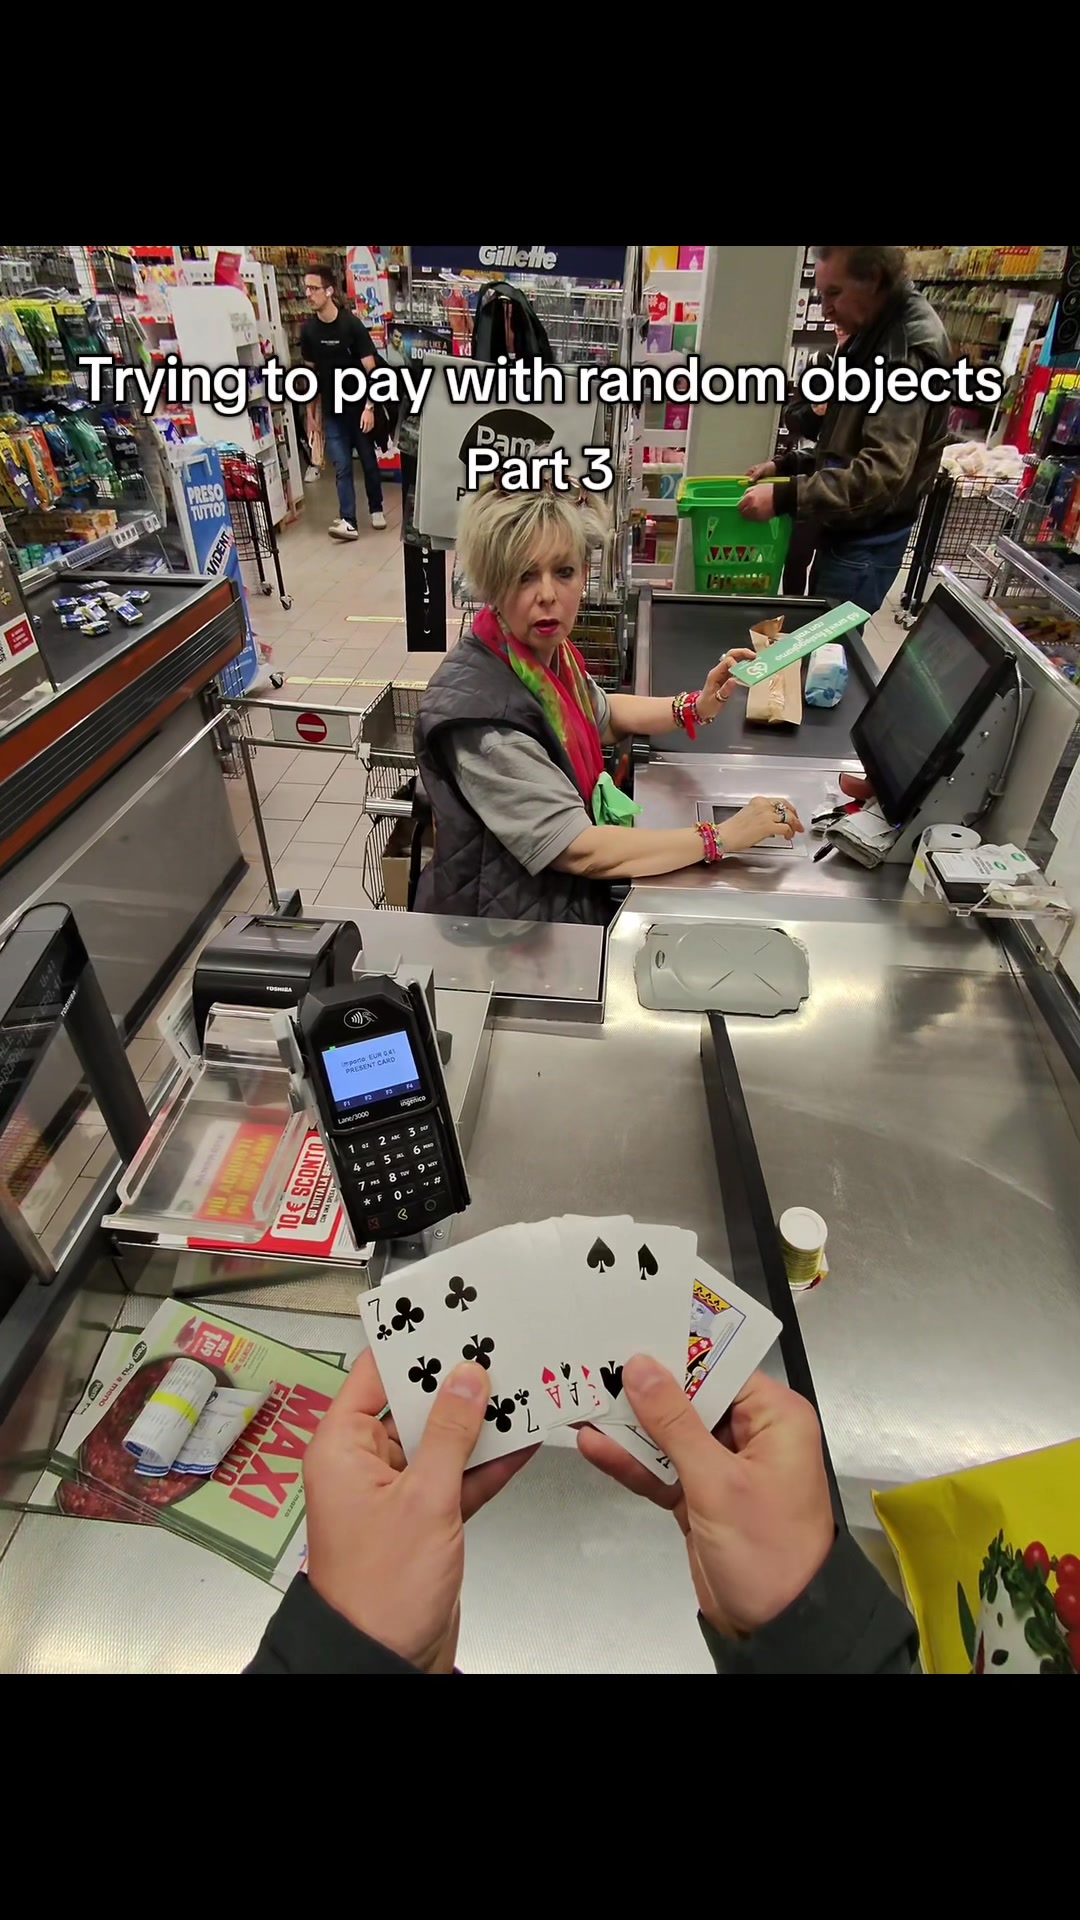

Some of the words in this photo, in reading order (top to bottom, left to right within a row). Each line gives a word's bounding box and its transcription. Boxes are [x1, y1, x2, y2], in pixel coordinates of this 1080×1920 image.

[479, 246, 557, 270] Gillette
[187, 483, 223, 505] PRESO
[191, 502, 226, 521] TUTTO?
[60, 989, 77, 1017] TOSHIBA
[369, 1051, 382, 1060] EUR
[345, 1062, 375, 1074] PRESENT
[377, 1056, 396, 1066] CARD
[400, 1095, 426, 1107] ingenico
[338, 1110, 369, 1124] Lane/3000
[408, 1127, 416, 1137] 3
[378, 1136, 386, 1146] 2
[348, 1144, 355, 1154] 1
[413, 1145, 421, 1155] 6
[353, 1162, 361, 1172] 4
[383, 1154, 391, 1165] 5
[291, 1142, 325, 1197] SCONTO
[417, 1163, 425, 1173] 9
[317, 1176, 328, 1188] LA
[388, 1172, 397, 1182] 8
[358, 1181, 365, 1191] 7
[310, 1188, 324, 1208] TUTTA
[377, 1194, 382, 1202] F
[393, 1190, 402, 1200] 0
[306, 1209, 317, 1219] SU
[368, 1298, 381, 1323] 7
[133, 1343, 146, 1360] Pam
[90, 1381, 103, 1399] Pam
[99, 1383, 118, 1407] meno
[545, 1384, 562, 1409] A
[527, 1408, 540, 1433] 7
[211, 1382, 291, 1487] FORMATO
[229, 1383, 335, 1519] MAXI
[284, 1495, 300, 1518] marzo
